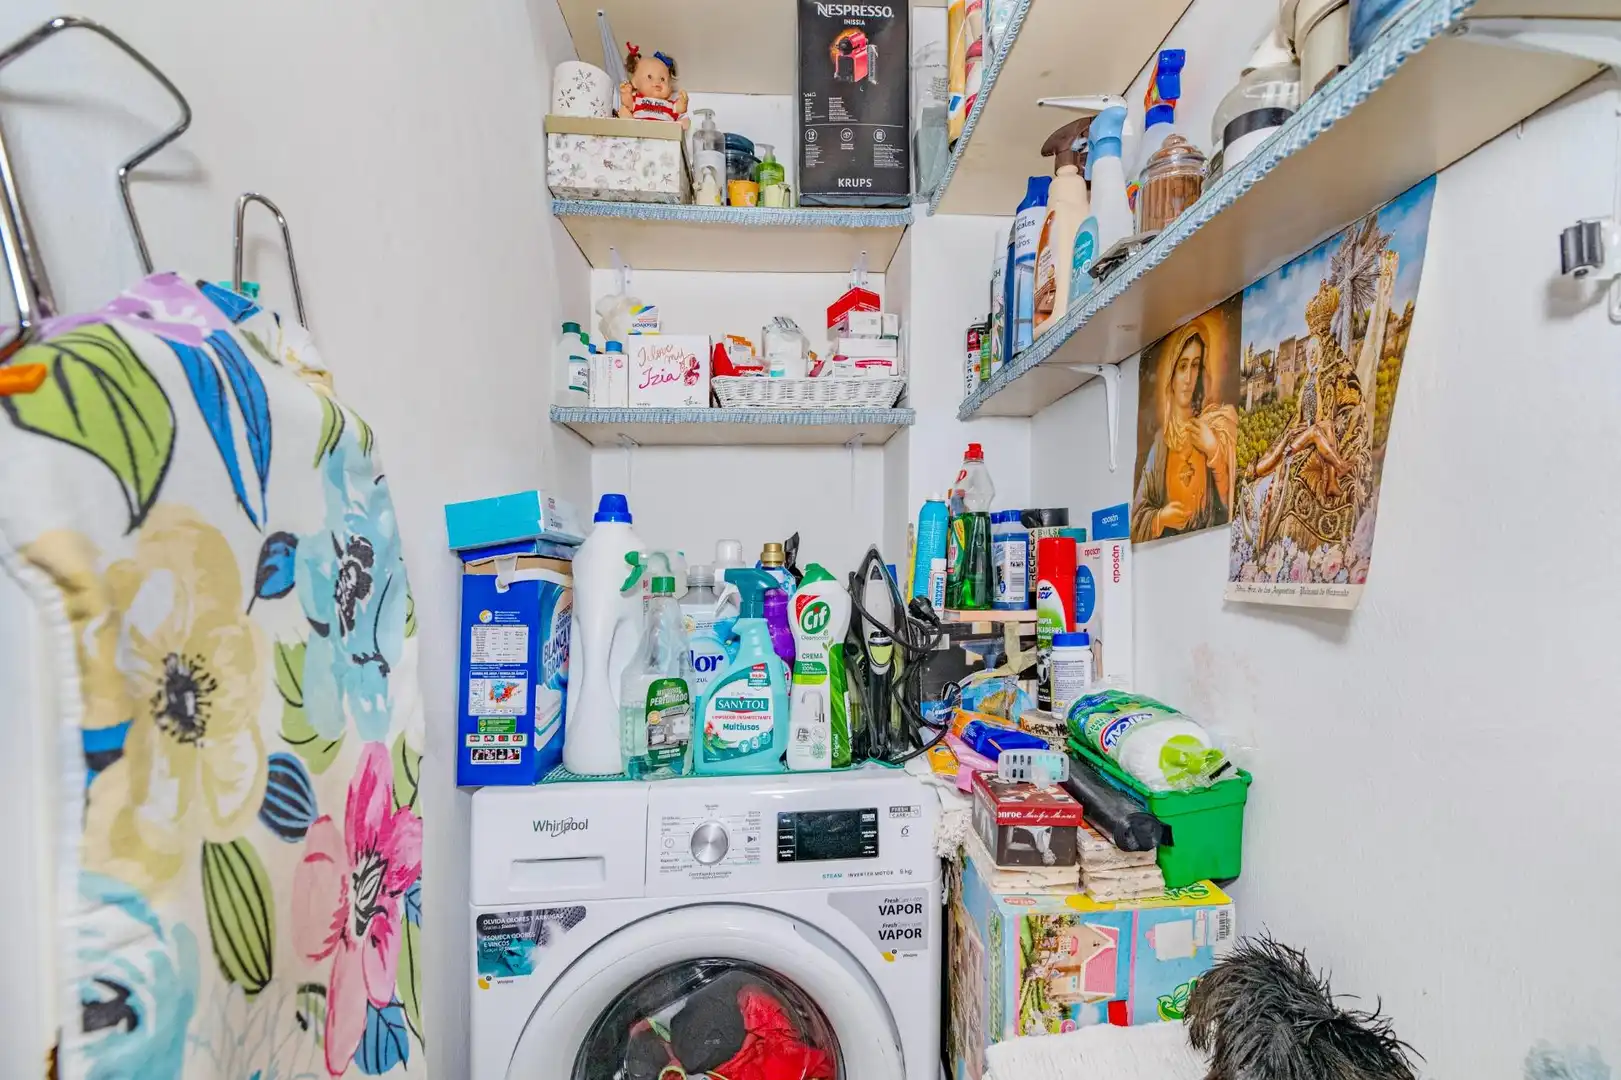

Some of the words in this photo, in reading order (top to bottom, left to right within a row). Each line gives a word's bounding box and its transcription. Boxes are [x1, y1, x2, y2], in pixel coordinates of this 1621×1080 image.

[838, 178, 873, 188] KRUPS
[1112, 545, 1121, 583] aposán
[803, 605, 827, 631] Cif
[690, 650, 724, 672] lor
[802, 652, 823, 660] CREMA
[718, 700, 766, 710] SANYTOL
[532, 816, 589, 838] Whirlpool
[878, 903, 923, 916] VAPOR
[483, 917, 507, 925] OLVIDA
[878, 928, 922, 940] VAPOR
